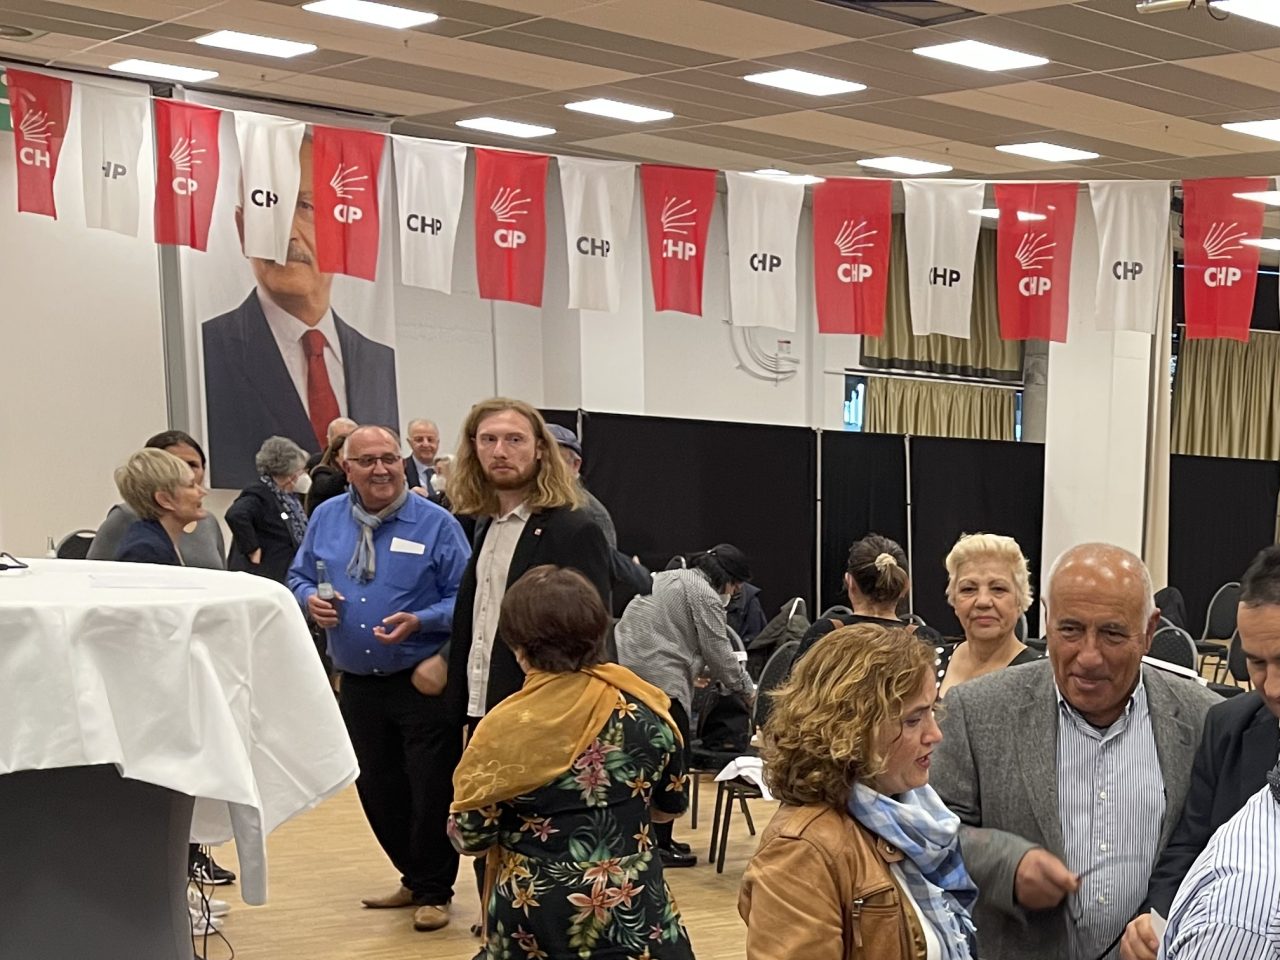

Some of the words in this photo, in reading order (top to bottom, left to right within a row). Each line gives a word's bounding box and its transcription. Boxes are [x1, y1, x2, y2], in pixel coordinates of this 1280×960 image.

[20, 147, 50, 168] CH
[172, 176, 198, 196] CP
[407, 214, 442, 235] CHP
[1113, 261, 1143, 281] CHP
[1204, 267, 1241, 287] CHP
